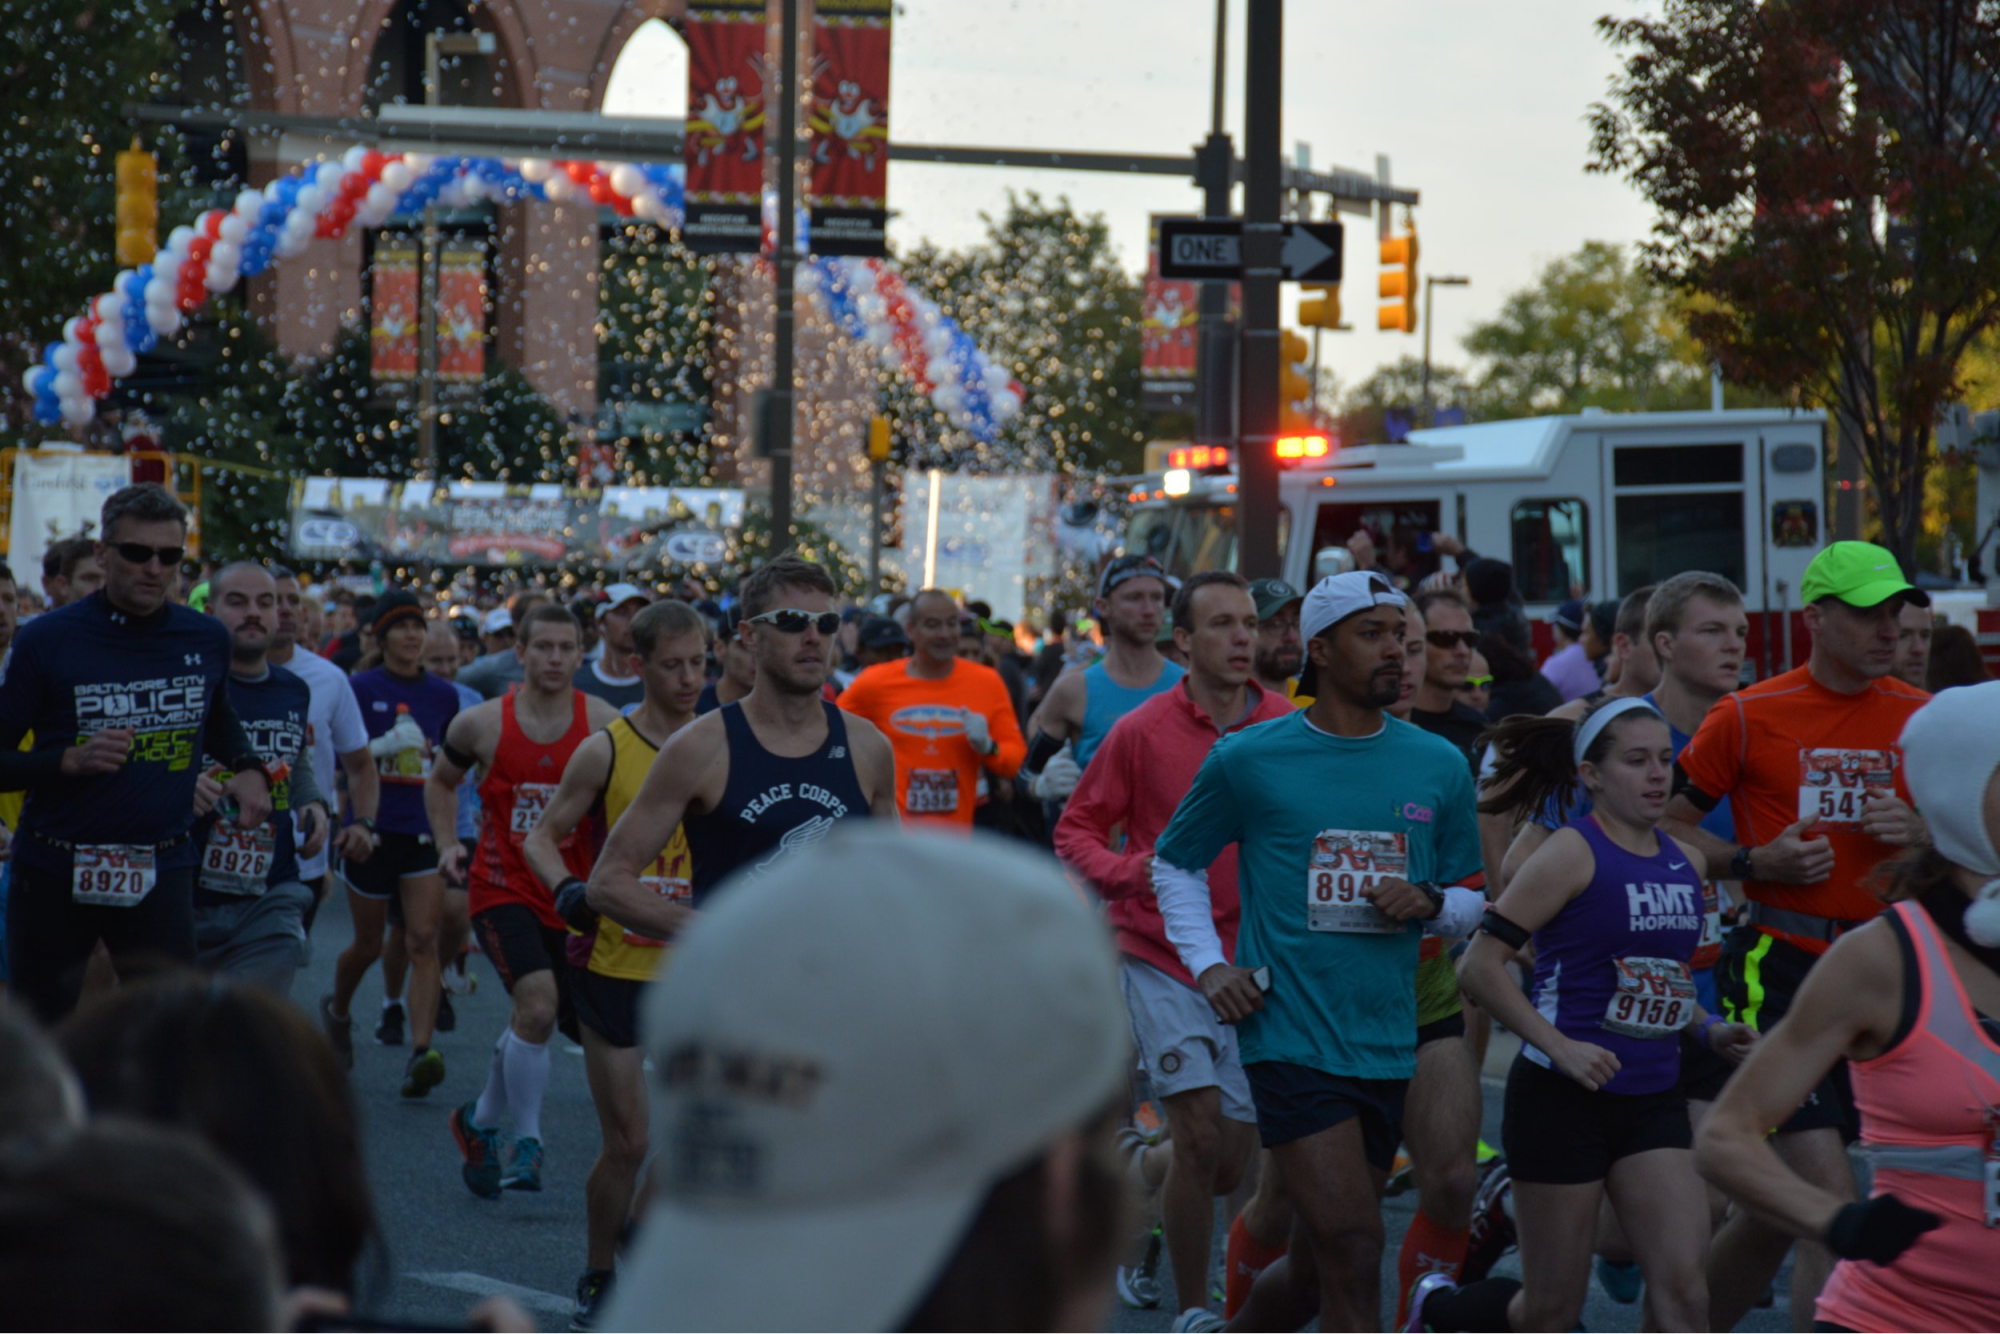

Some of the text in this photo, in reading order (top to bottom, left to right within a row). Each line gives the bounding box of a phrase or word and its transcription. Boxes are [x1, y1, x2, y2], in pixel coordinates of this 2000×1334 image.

[1179, 237, 1227, 261] ONE
[74, 674, 205, 696] BALTIMORE CITY
[75, 686, 205, 718] POLICE
[77, 708, 204, 730] DEPARTMENT
[246, 730, 302, 754] LICE
[739, 783, 848, 824] PEACE CORPS
[209, 848, 265, 874] 8926
[79, 869, 143, 893] 8920
[1316, 872, 1392, 903] 894
[1625, 883, 1695, 916] HMT
[1630, 915, 1700, 932] HOPKINS
[1616, 995, 1682, 1027] 9158
